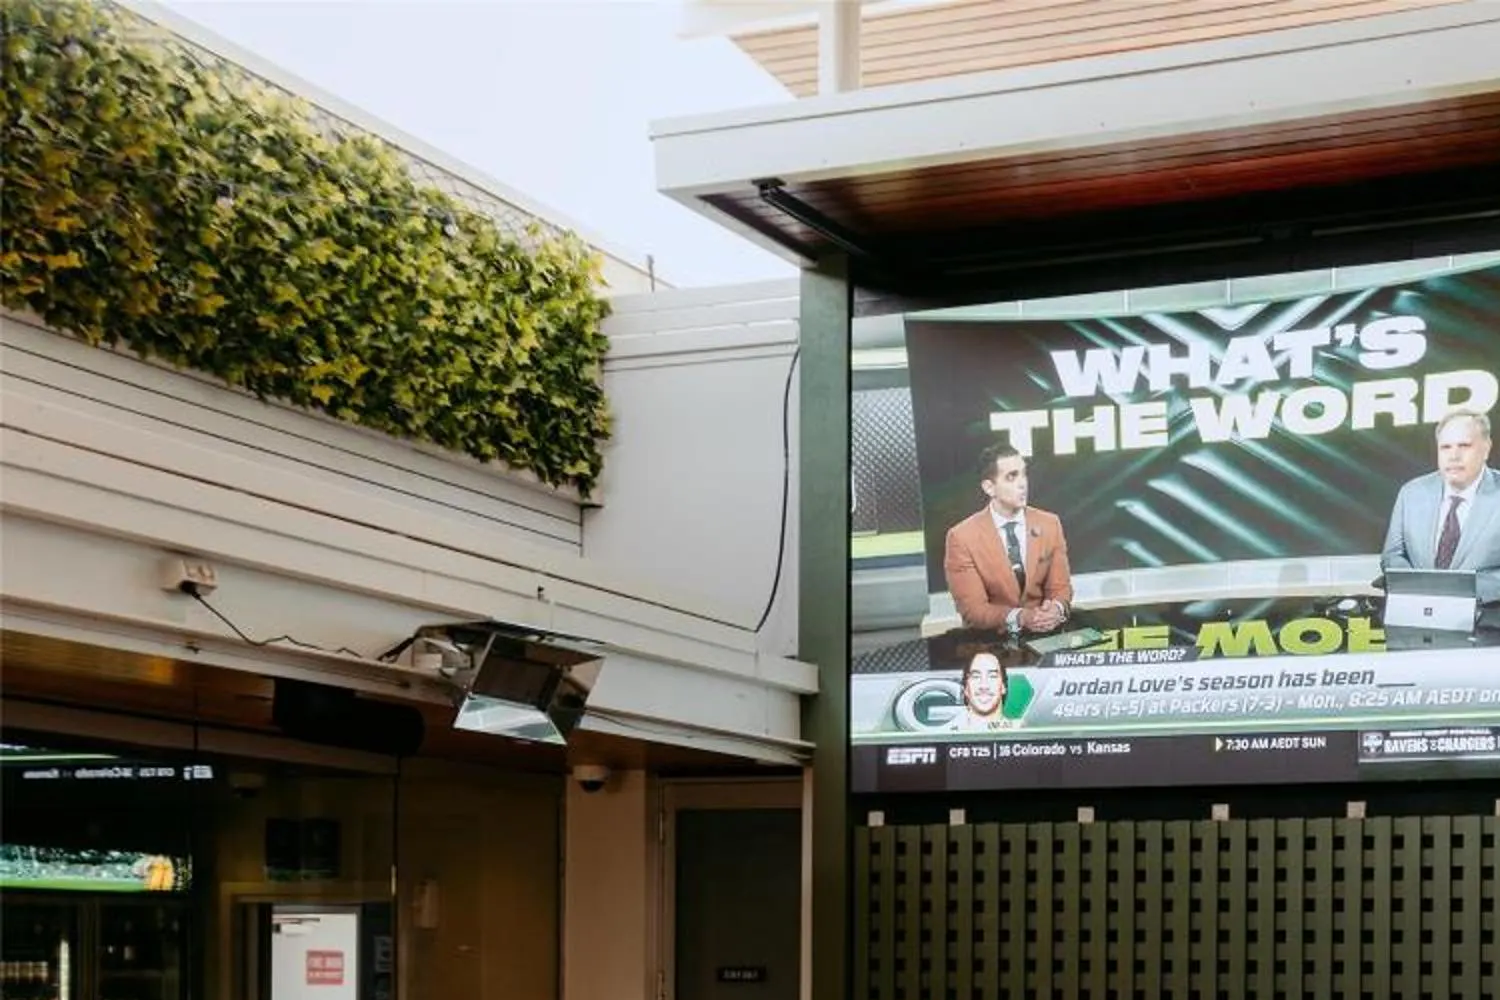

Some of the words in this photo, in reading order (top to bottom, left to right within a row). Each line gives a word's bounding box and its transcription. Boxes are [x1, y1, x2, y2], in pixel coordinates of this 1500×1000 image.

[1051, 316, 1427, 396] WHAT'S
[990, 401, 1168, 457] THE
[1190, 370, 1499, 442] WORD
[1053, 651, 1104, 666] WHAT'S
[1108, 650, 1135, 664] THE
[1136, 649, 1186, 663] WORD?
[1054, 678, 1123, 697] Jordan
[1127, 675, 1194, 693] Love's
[1198, 672, 1273, 691] season
[1277, 670, 1318, 688] has
[1321, 669, 1375, 686] been
[1053, 701, 1100, 718] 49ers
[1105, 699, 1143, 719] (5-5)
[1149, 700, 1163, 715] at
[1169, 697, 1238, 715] Packers
[1393, 689, 1422, 705] AM
[1426, 687, 1475, 704] AEDT
[1012, 742, 1066, 757] Colorado
[1087, 741, 1131, 754] Kansas
[1225, 739, 1249, 751] 7:30
[1250, 737, 1269, 749] AM
[1270, 736, 1301, 749] AEDT
[1302, 735, 1327, 748] SUN
[886, 747, 937, 765] ESPN
